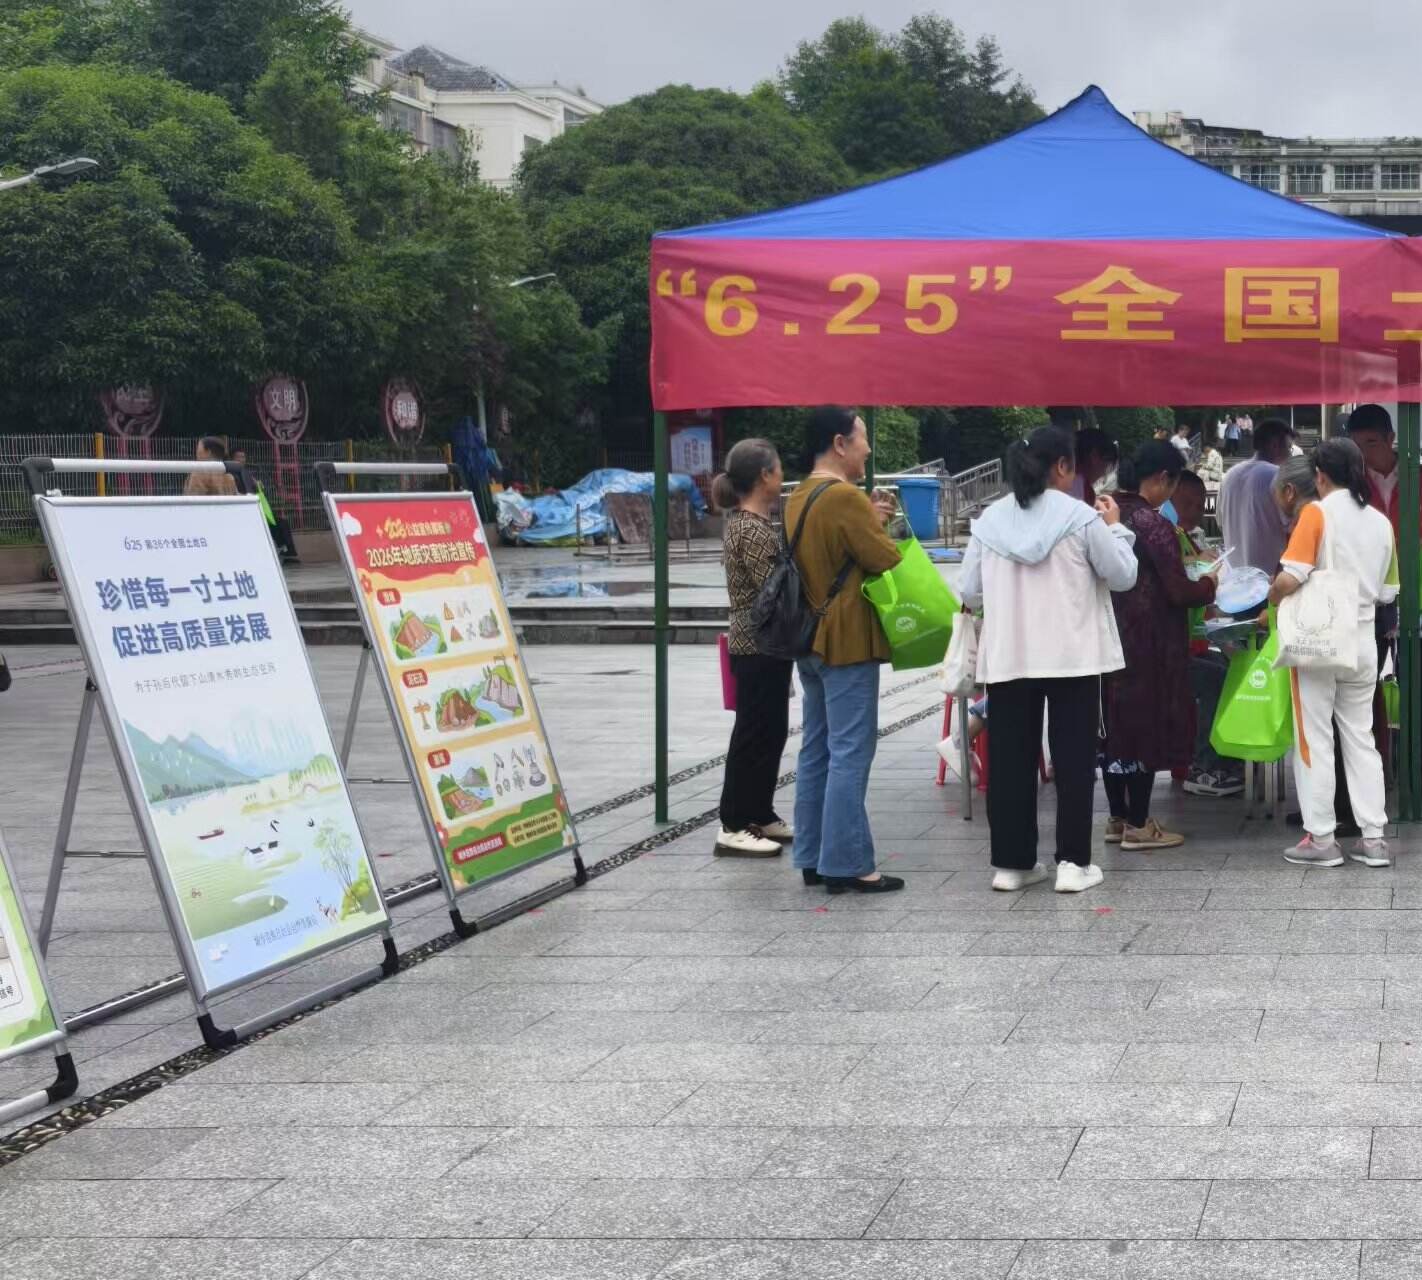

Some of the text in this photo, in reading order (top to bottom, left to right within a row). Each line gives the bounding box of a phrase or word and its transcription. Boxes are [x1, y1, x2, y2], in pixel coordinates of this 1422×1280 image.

[270, 389, 297, 409] 文明
[366, 540, 476, 568] 2026年地质灾害防治宣传
[95, 570, 259, 612] 珍惜每一寸土地
[111, 611, 272, 659] 促进高质量发展
